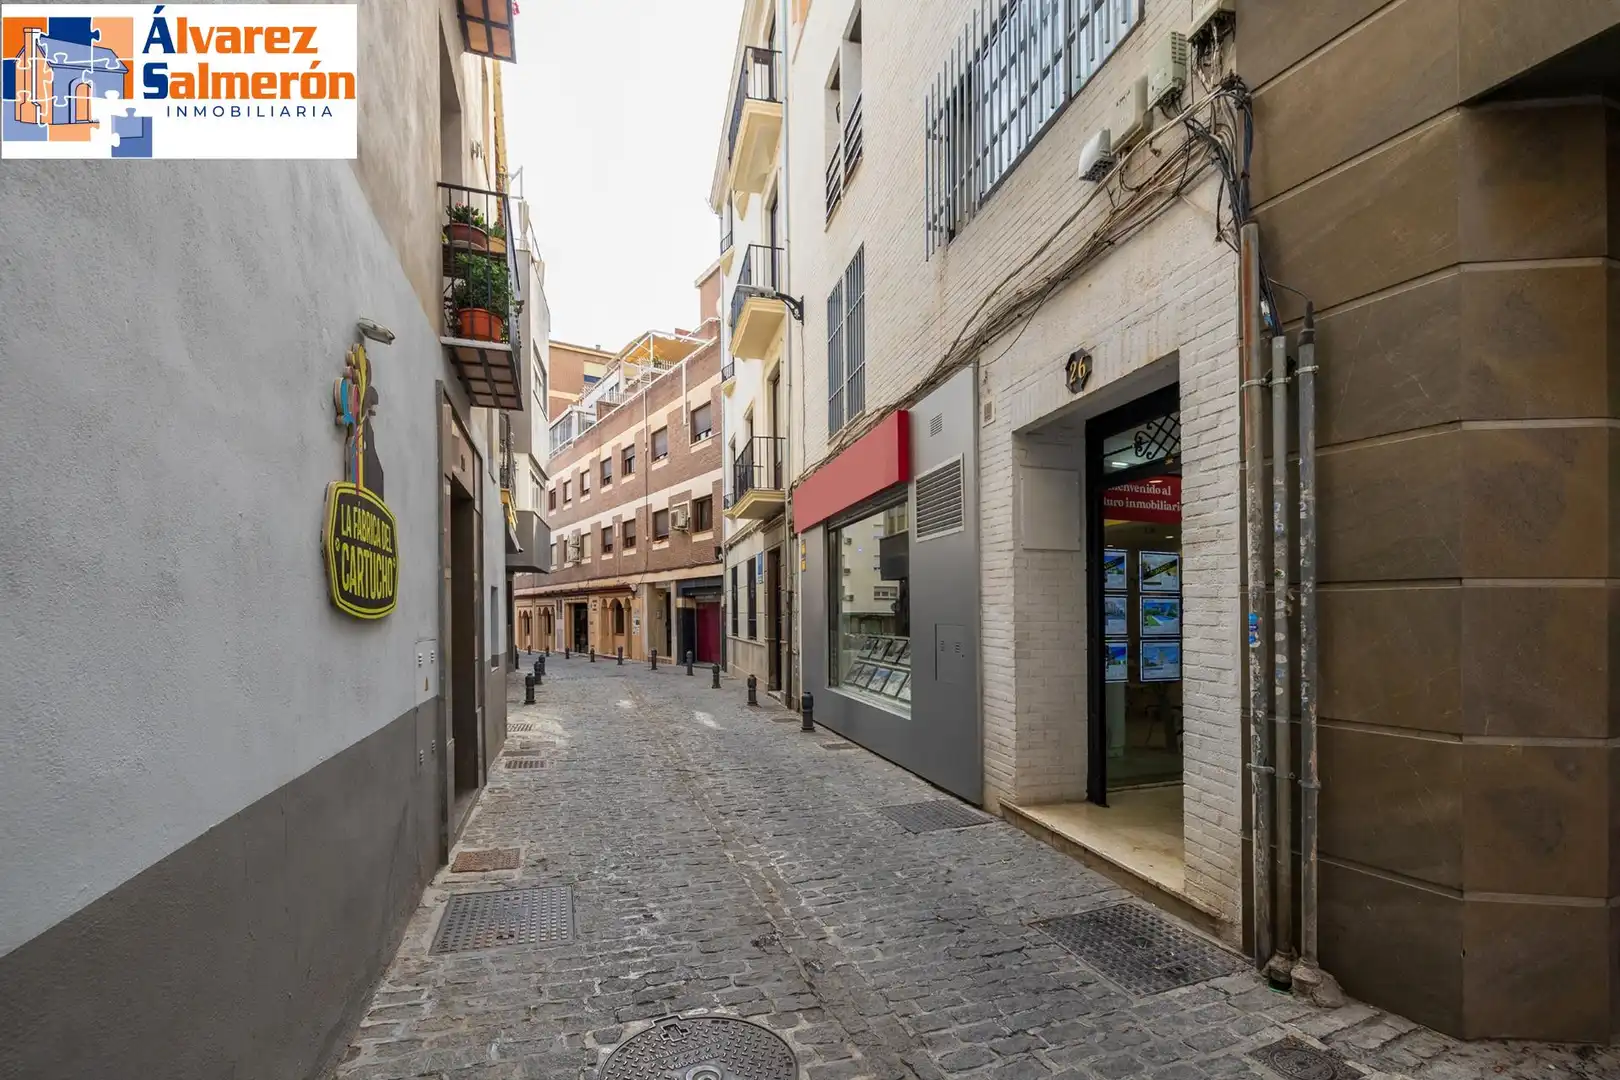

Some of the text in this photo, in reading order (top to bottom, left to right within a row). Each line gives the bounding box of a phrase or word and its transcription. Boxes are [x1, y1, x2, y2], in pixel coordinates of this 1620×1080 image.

[1069, 356, 1086, 383] 26
[1162, 485, 1172, 496] al
[1125, 497, 1182, 512] inmobiliari
[341, 503, 351, 538] LA
[381, 520, 393, 553] DEL
[341, 542, 393, 600] CARTUCHO
